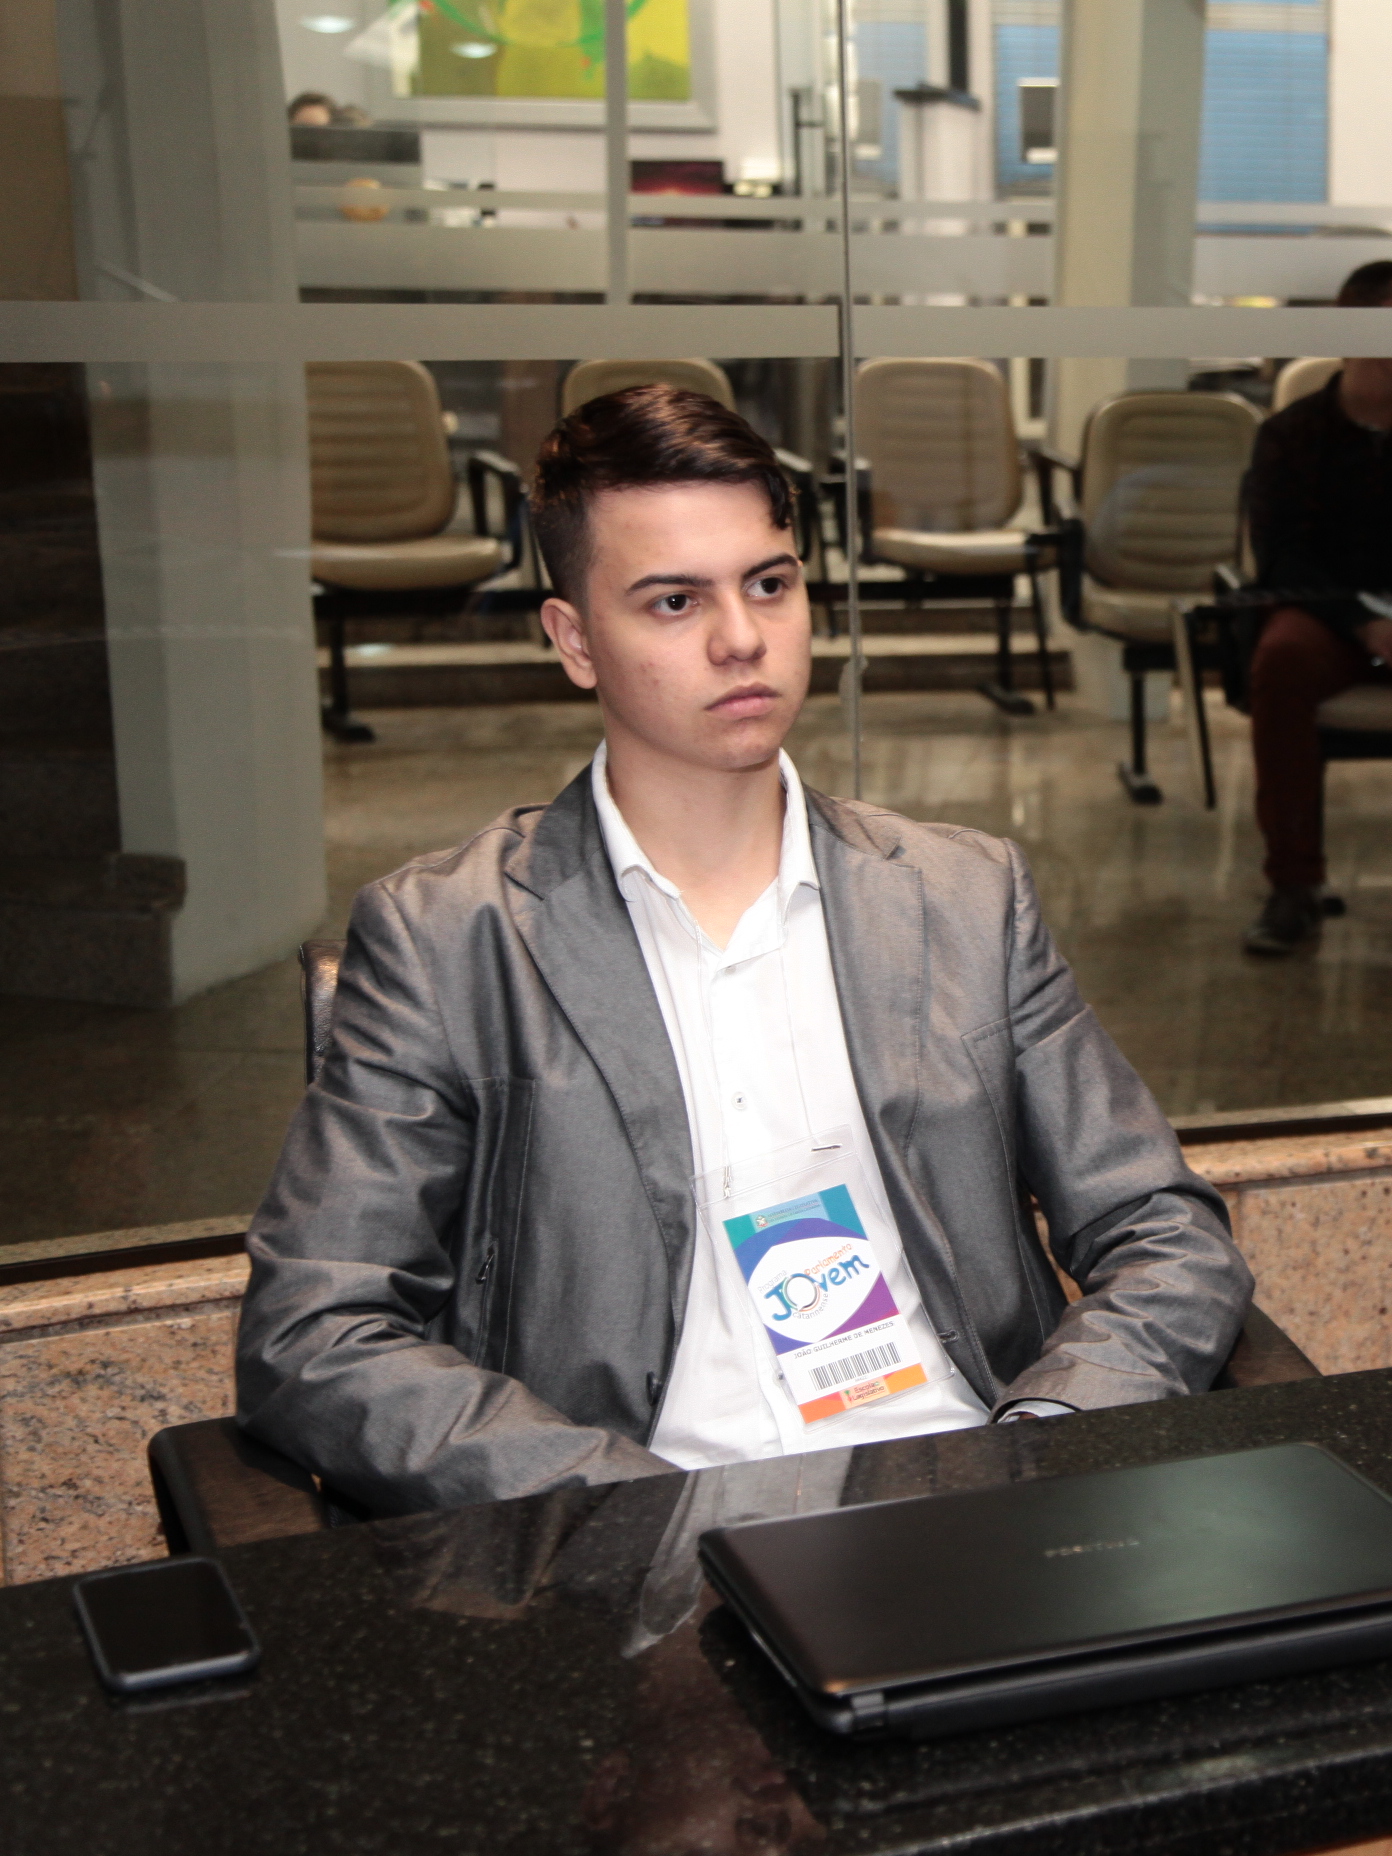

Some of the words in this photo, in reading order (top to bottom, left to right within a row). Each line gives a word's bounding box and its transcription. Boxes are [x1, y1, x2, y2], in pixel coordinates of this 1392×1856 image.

[803, 1243, 852, 1276] Parlamento
[757, 1270, 787, 1293] Programa
[794, 1347, 812, 1359] JOÃO
[813, 1335, 852, 1353] GUILHERME
[853, 1331, 863, 1339] DE
[864, 1321, 894, 1335] MENEZES
[854, 1382, 874, 1394] Escola
